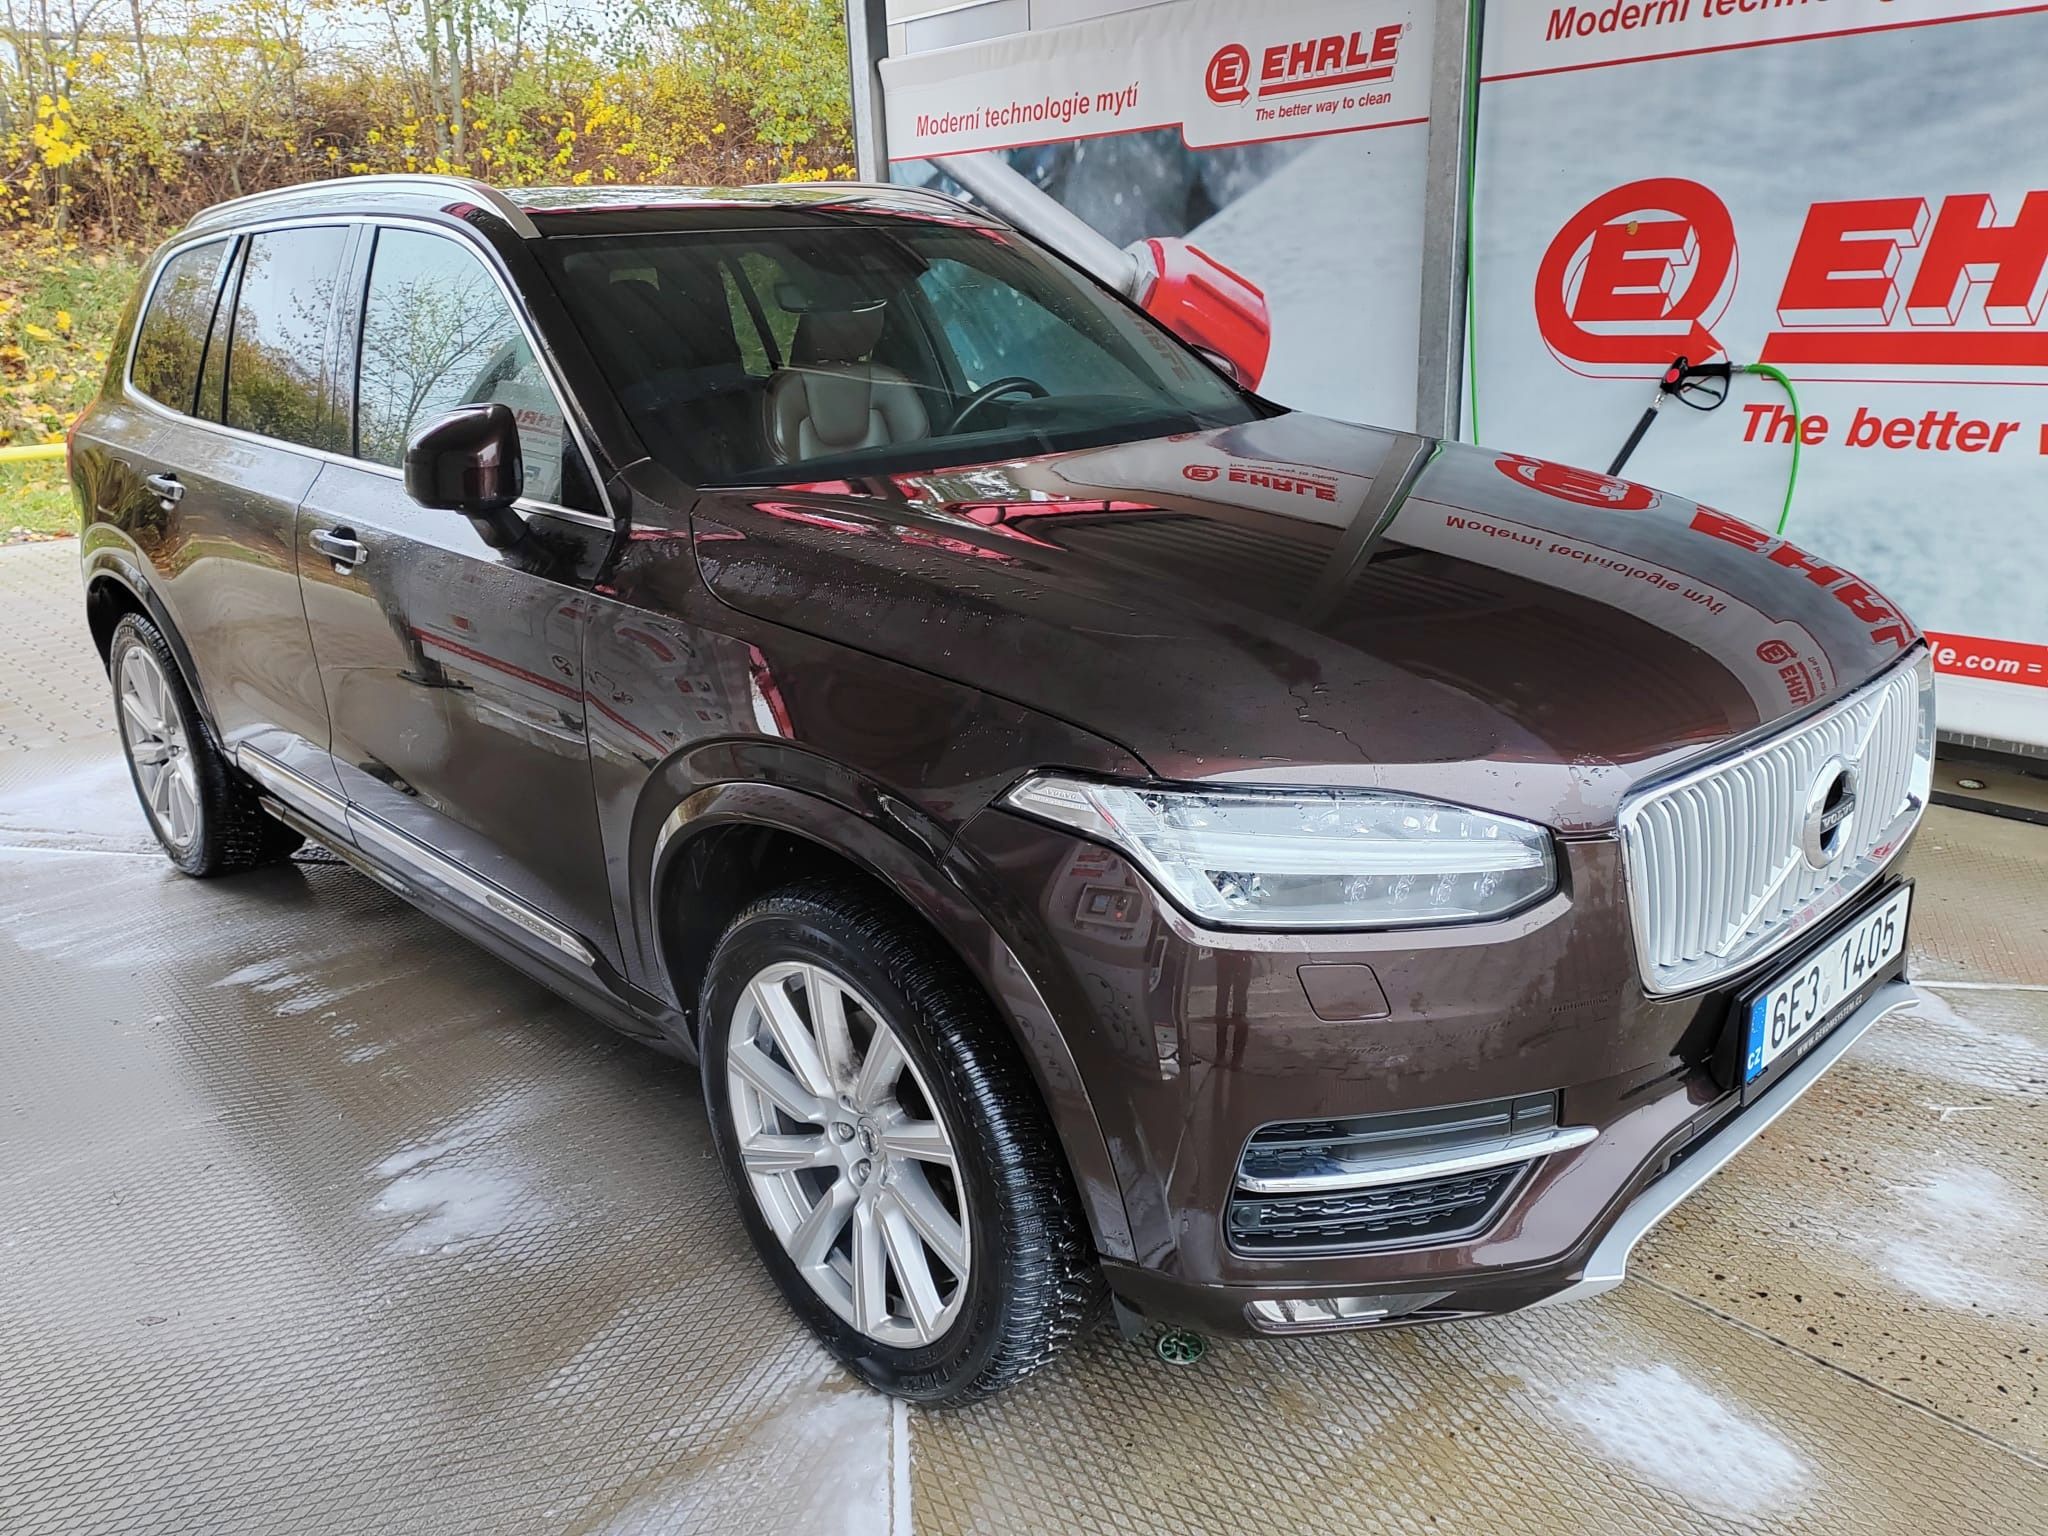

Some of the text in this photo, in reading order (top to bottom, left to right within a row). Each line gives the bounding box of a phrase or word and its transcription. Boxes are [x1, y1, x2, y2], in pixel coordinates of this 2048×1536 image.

[1261, 23, 1403, 82] EHRLE
[916, 81, 1140, 137] Moderní technologie mytí
[1255, 92, 1392, 121] The better way to clean
[1742, 403, 2021, 453] The better
[1822, 801, 1854, 828] VOLVO
[1771, 903, 1898, 1049] 6E3 1405
[1747, 1047, 1763, 1070] CZ
